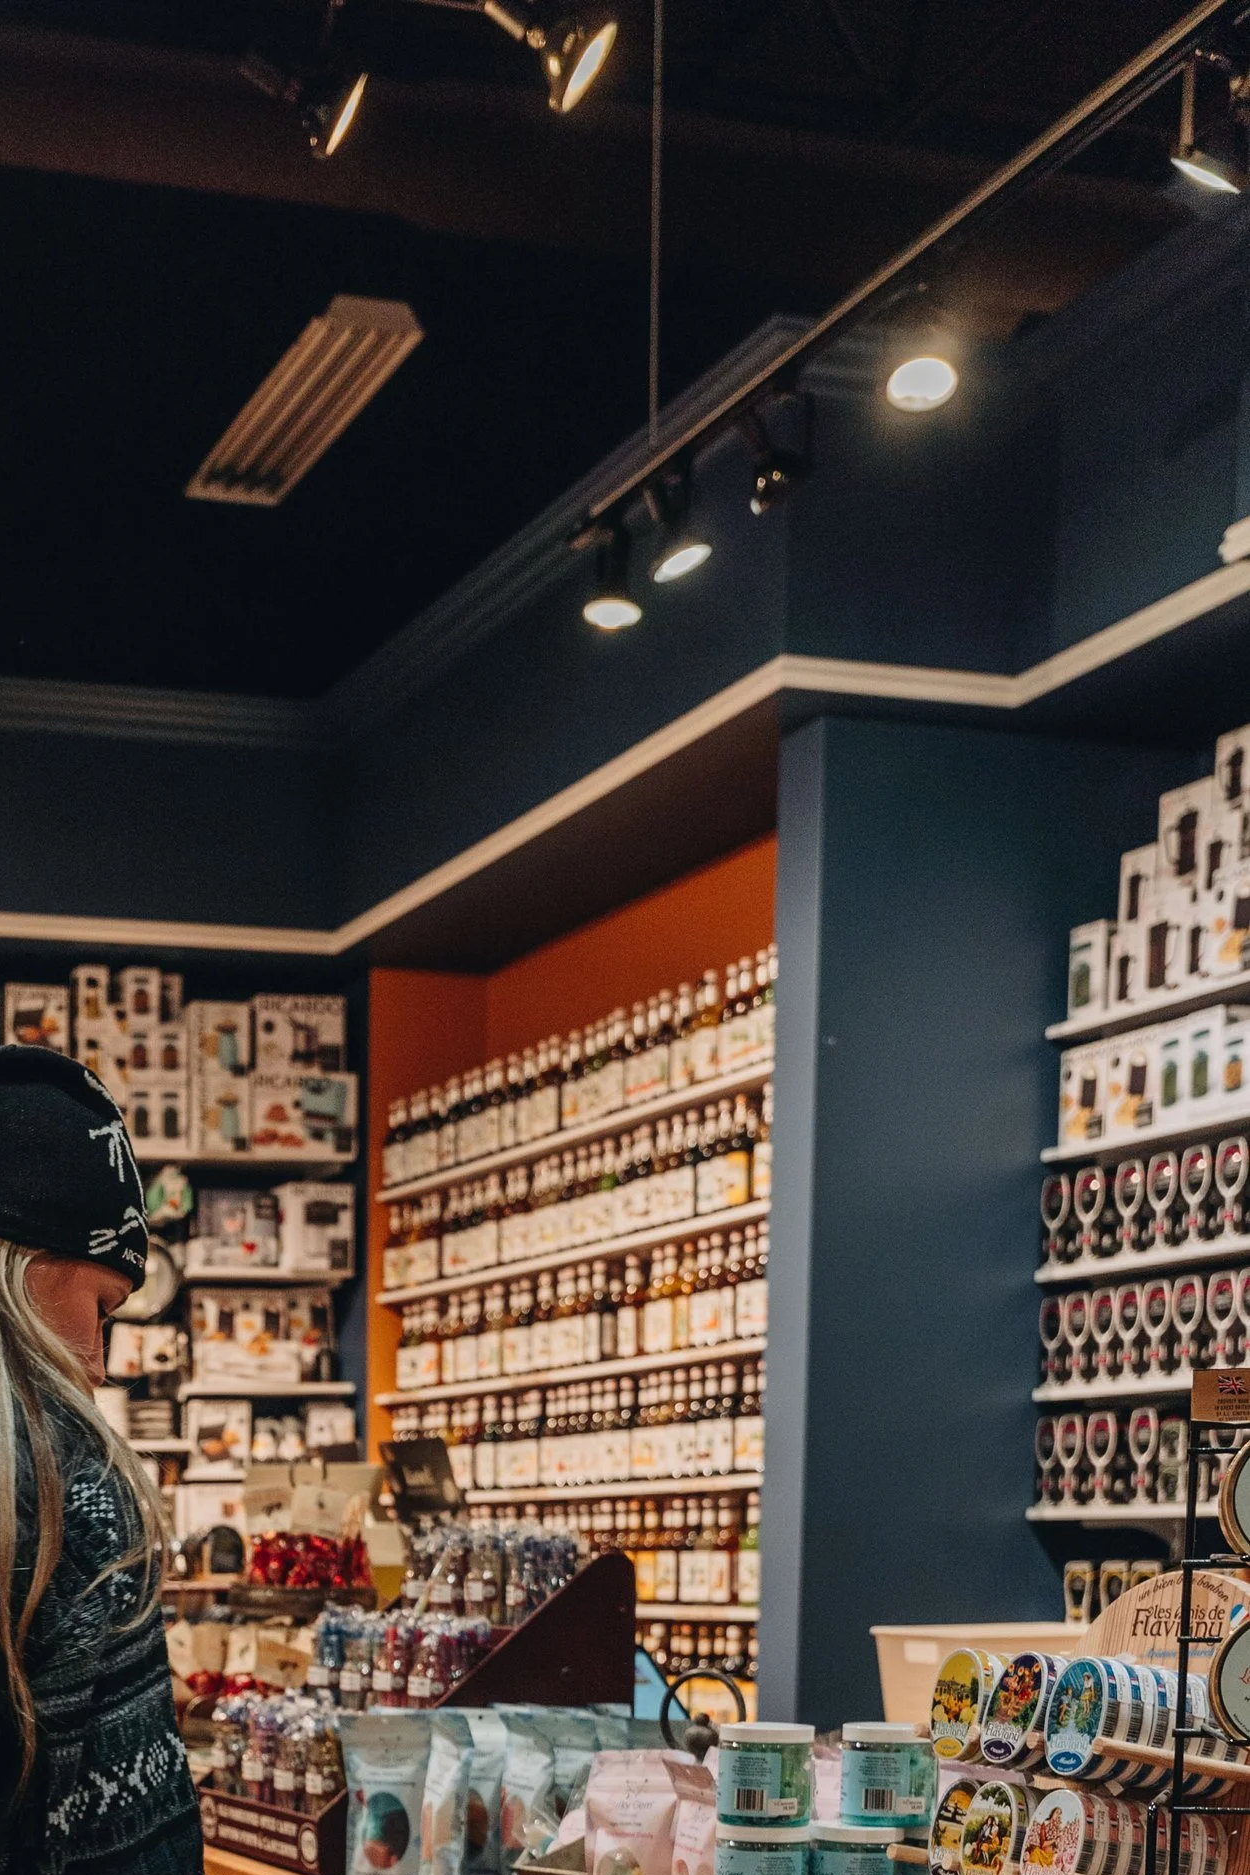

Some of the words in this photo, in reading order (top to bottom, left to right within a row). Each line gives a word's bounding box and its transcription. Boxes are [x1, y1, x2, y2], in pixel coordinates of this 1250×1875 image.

[1152, 1576, 1175, 1593] bien
[1196, 1574, 1230, 1603] bonbon
[1153, 1604, 1172, 1619] les
[1208, 1604, 1226, 1620] de
[1131, 1607, 1224, 1646] Flaviny
[985, 1724, 1021, 1743] Flavigny
